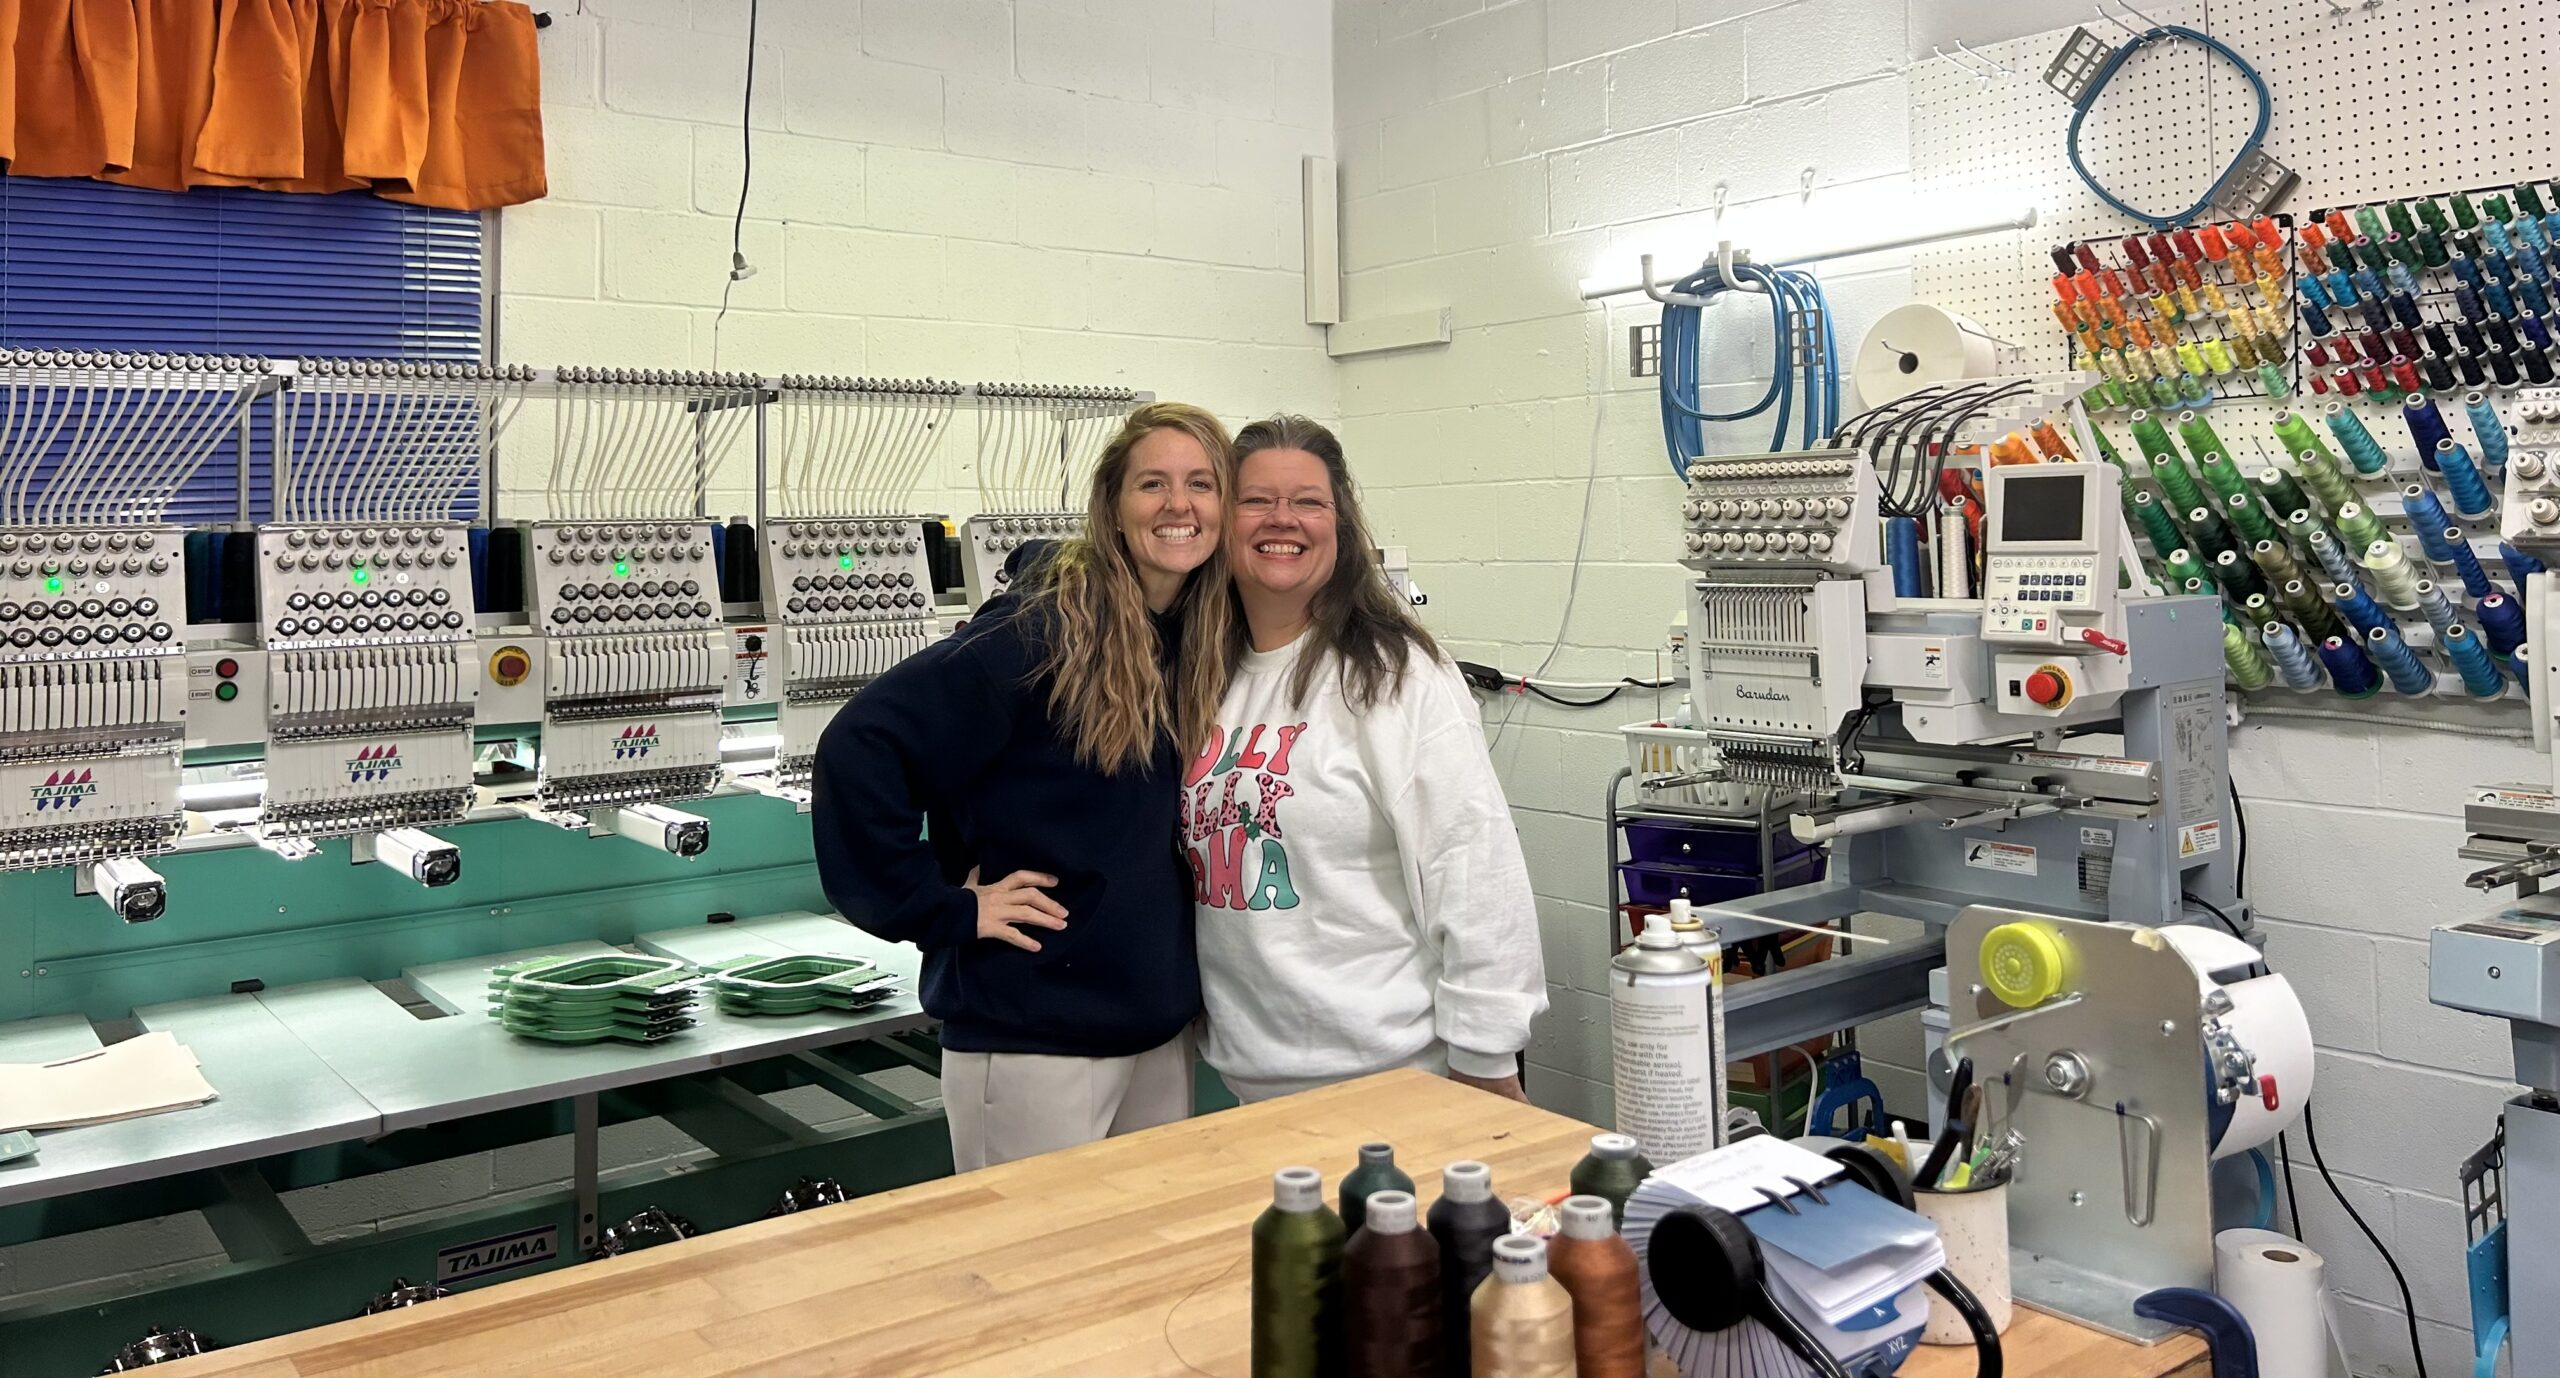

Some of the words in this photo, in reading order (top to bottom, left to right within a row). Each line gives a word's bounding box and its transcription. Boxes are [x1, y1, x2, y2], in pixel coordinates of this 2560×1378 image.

[1736, 684, 1790, 702] Barudan
[612, 737, 660, 748] TAJIMA
[346, 758, 402, 771] TAJIMA
[31, 783, 97, 798] TAJIMA
[447, 1237, 548, 1274] TAJIMA
[1872, 1306, 1886, 1318] A
[1886, 1336, 1909, 1356] XYZ
